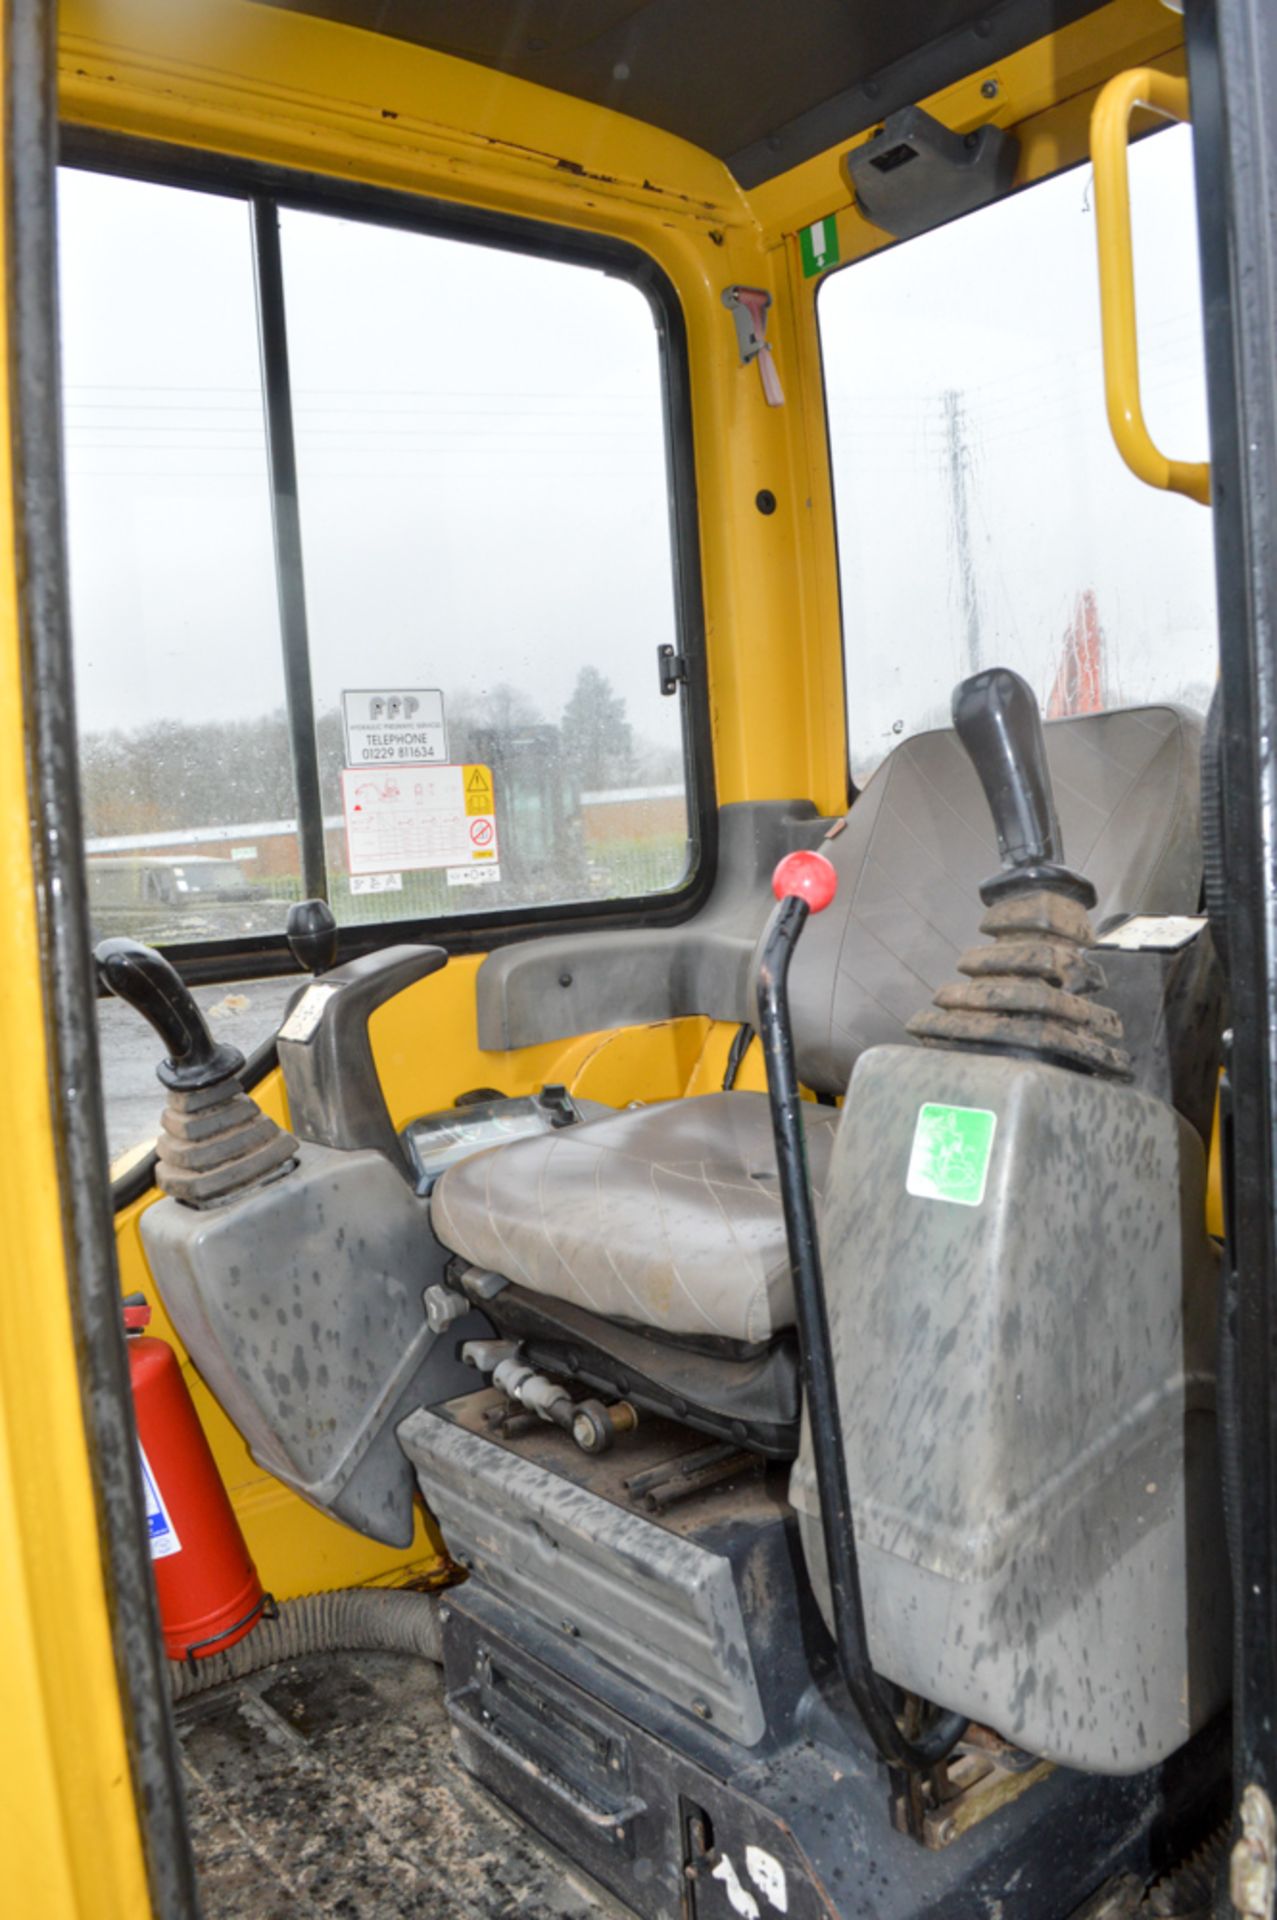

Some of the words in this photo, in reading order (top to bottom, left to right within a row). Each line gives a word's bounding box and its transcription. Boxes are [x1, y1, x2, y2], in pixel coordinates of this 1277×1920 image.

[366, 733, 427, 745] TELEPHONE
[362, 747, 395, 760] 01229
[398, 746, 434, 758] 811634
